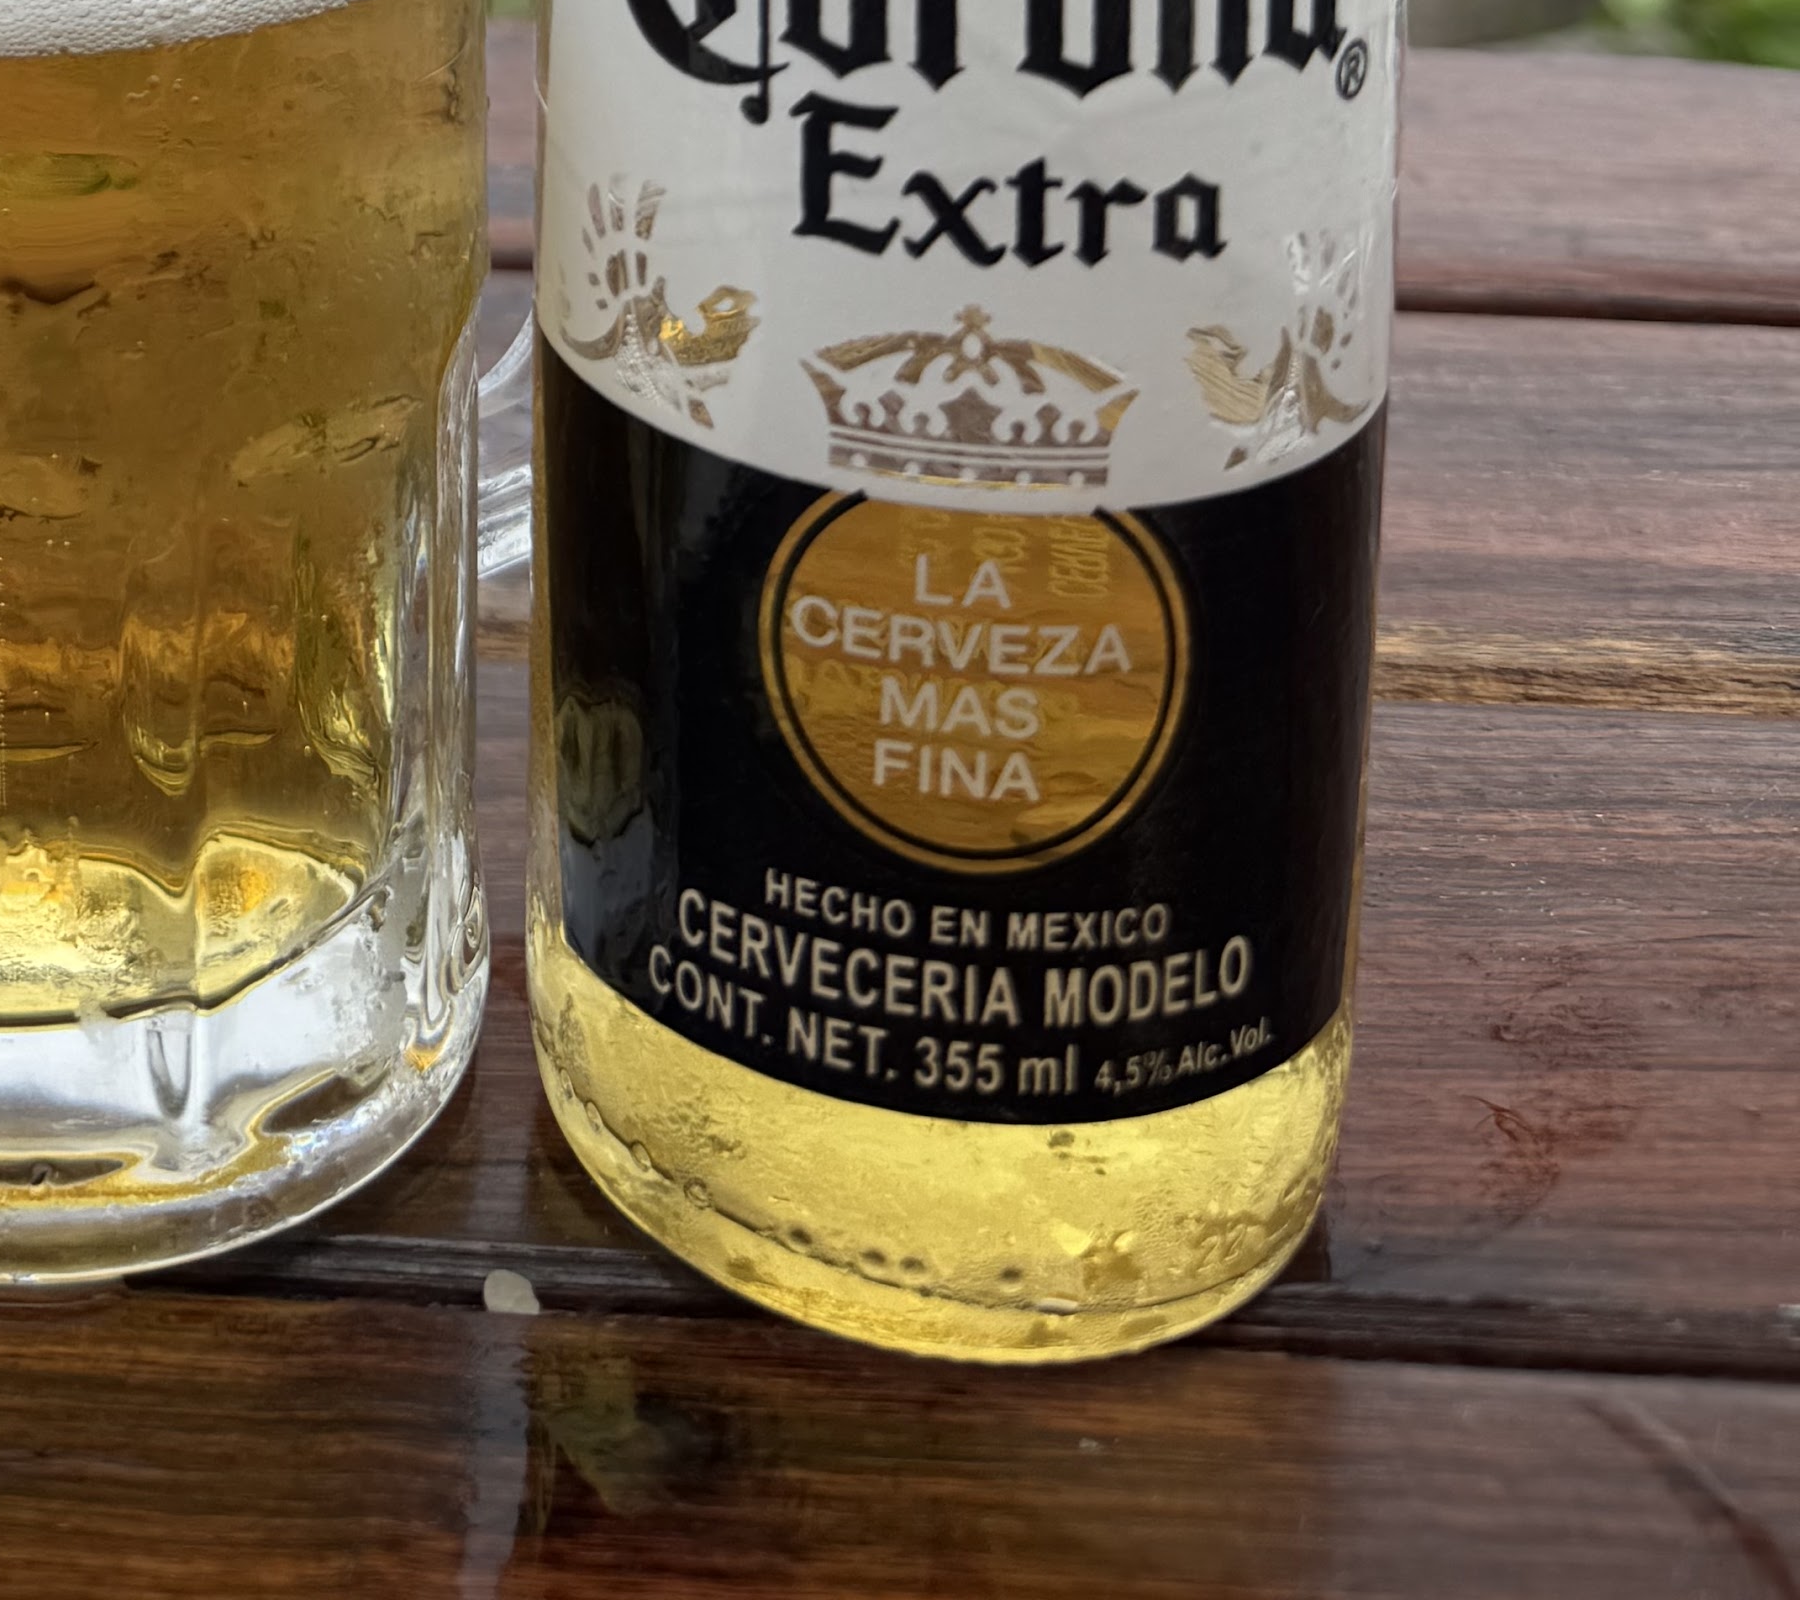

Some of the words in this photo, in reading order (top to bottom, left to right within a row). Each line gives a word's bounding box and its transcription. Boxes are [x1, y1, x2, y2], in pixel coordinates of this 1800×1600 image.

[789, 91, 1229, 268] Extra
[914, 553, 1012, 609] LA
[789, 595, 1133, 677] CERVEZA
[879, 676, 1040, 739] MAS
[872, 738, 1041, 801] FINA
[764, 866, 916, 938] HECHO
[929, 904, 991, 948] EN
[1006, 902, 1172, 949] MEXICO
[677, 887, 1022, 1028] CERVECERIA
[1043, 934, 1252, 1028] MODELO
[649, 944, 774, 1046] CONT.
[786, 1005, 898, 1081] NET.
[914, 1036, 1004, 1093] 355
[1017, 1043, 1080, 1095] ml
